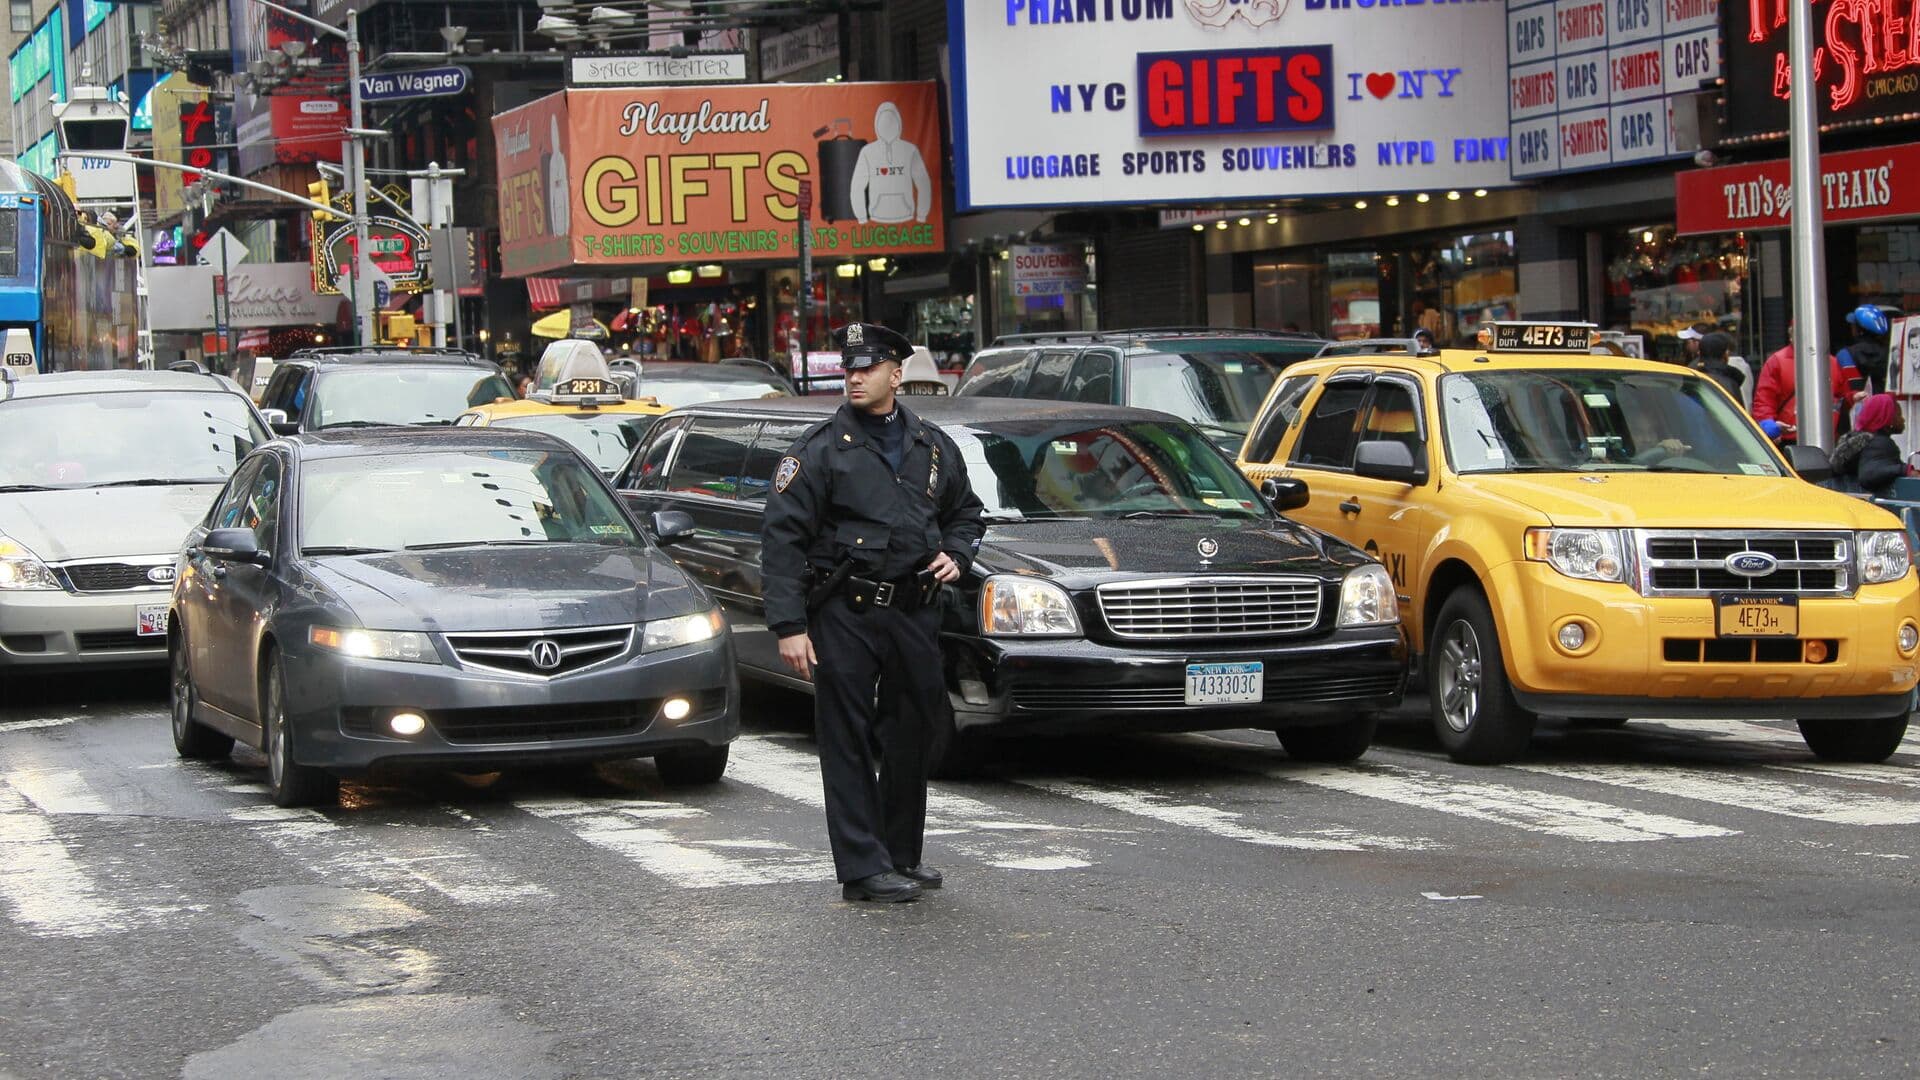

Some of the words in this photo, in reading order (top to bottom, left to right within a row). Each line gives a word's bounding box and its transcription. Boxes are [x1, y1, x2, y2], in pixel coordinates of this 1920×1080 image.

[1006, 0, 1174, 26] PHANTOM
[1557, 3, 1604, 44] T-SHIRTS
[1617, 0, 1649, 32] CAPS
[1516, 16, 1545, 53] CAPS
[588, 61, 640, 80] SAGE
[646, 59, 730, 79] THEATER
[1611, 50, 1660, 92] T-SHIRTS
[1675, 37, 1710, 78] CAPS
[364, 78, 393, 94] Van
[397, 73, 460, 92] Wagner
[1050, 82, 1126, 113] NYC
[1147, 53, 1325, 127] GIFTS
[1398, 68, 1462, 99] NY
[1511, 71, 1555, 110] T-SHIRTS
[1566, 62, 1597, 99] CAPS
[620, 99, 771, 144] Playland
[1561, 118, 1608, 157] T-SHIRTS
[1620, 111, 1654, 150] CAPS
[1006, 154, 1100, 179] LUGGAGE
[1122, 150, 1206, 175] SPORTS
[1222, 143, 1356, 171] SOUVENIRS
[1377, 140, 1436, 166] NYPD
[1453, 137, 1509, 163] FDNY
[1519, 128, 1549, 164] CAPS
[81, 158, 111, 170] NYPD
[582, 150, 810, 228] GIFTS
[1724, 175, 1773, 219] TAD'S
[1823, 166, 1891, 210] TEAKS
[500, 168, 545, 243] GIFTS
[583, 233, 665, 257] T-SHIRTS
[677, 230, 778, 254] SOUVENIRS
[852, 225, 934, 248] LUGGAGE
[1499, 338, 1518, 347] DUTY
[1502, 328, 1516, 336] OFF
[1522, 326, 1564, 345] 4E73
[1567, 339, 1587, 347] DUTY
[1571, 329, 1584, 337] OFF
[8, 354, 30, 365] 1E79
[572, 380, 600, 393] 2P31
[1741, 558, 1766, 569] Ford
[1191, 674, 1256, 697] T433303C
[1204, 666, 1224, 675] NEW
[1225, 665, 1245, 674] YORK
